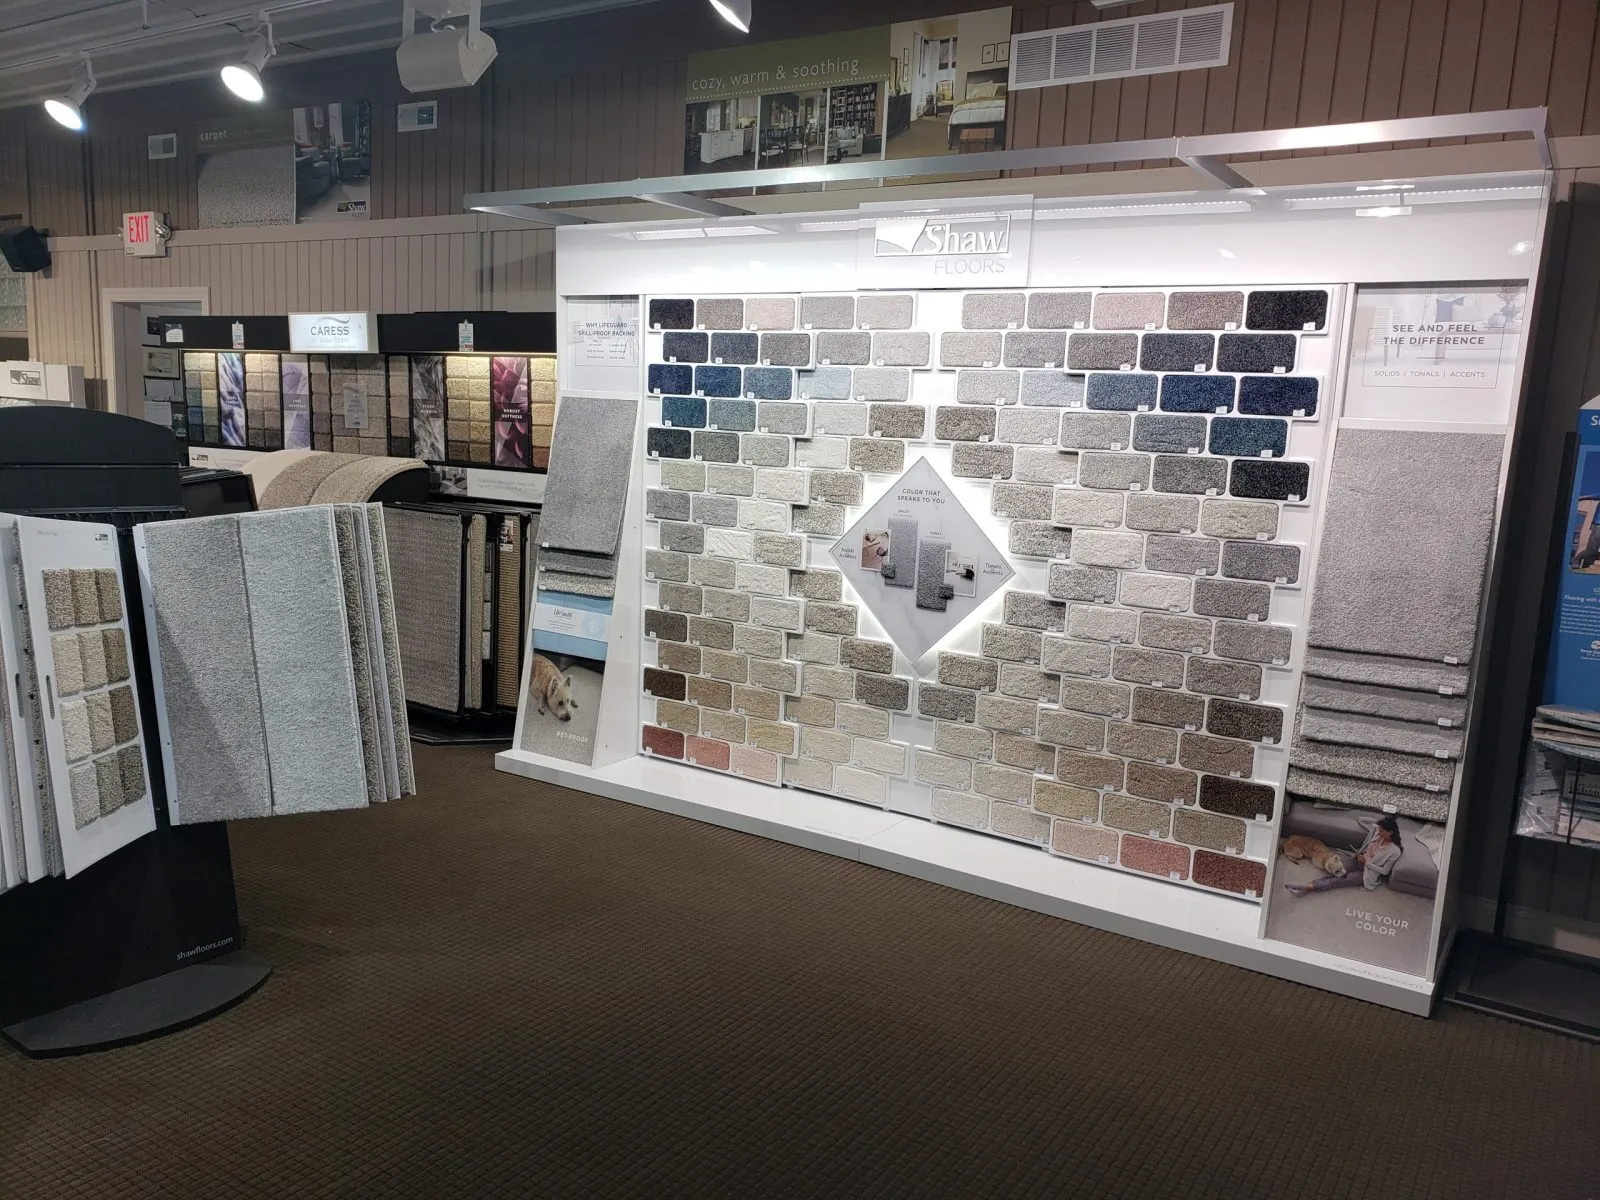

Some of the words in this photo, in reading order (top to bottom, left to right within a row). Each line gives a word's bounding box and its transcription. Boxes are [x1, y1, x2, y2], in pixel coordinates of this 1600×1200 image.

[692, 76, 725, 92] cozy,
[731, 70, 769, 85] warm
[776, 65, 786, 80] &
[793, 57, 860, 78] soothing
[200, 129, 228, 142] carpet
[348, 202, 367, 212] Shaw
[128, 215, 149, 243] EXIT
[924, 223, 1006, 253] Shaw
[934, 258, 1005, 275] FLOORS
[310, 326, 350, 336] CARESS
[1392, 324, 1414, 333] SEE
[1418, 324, 1444, 332] AND
[1448, 324, 1478, 332] FEEL
[1384, 336, 1405, 345] THE
[1409, 336, 1486, 345] DIFFERENCE
[1590, 415, 1600, 426] S
[902, 488, 923, 496] COLOR
[925, 489, 941, 497] THAT
[556, 730, 589, 743] PET-PROOF
[1346, 907, 1372, 921] LIVE
[1376, 914, 1409, 929] YOUR
[1355, 921, 1396, 937] COLOR
[176, 937, 233, 961] shawfloors.com
